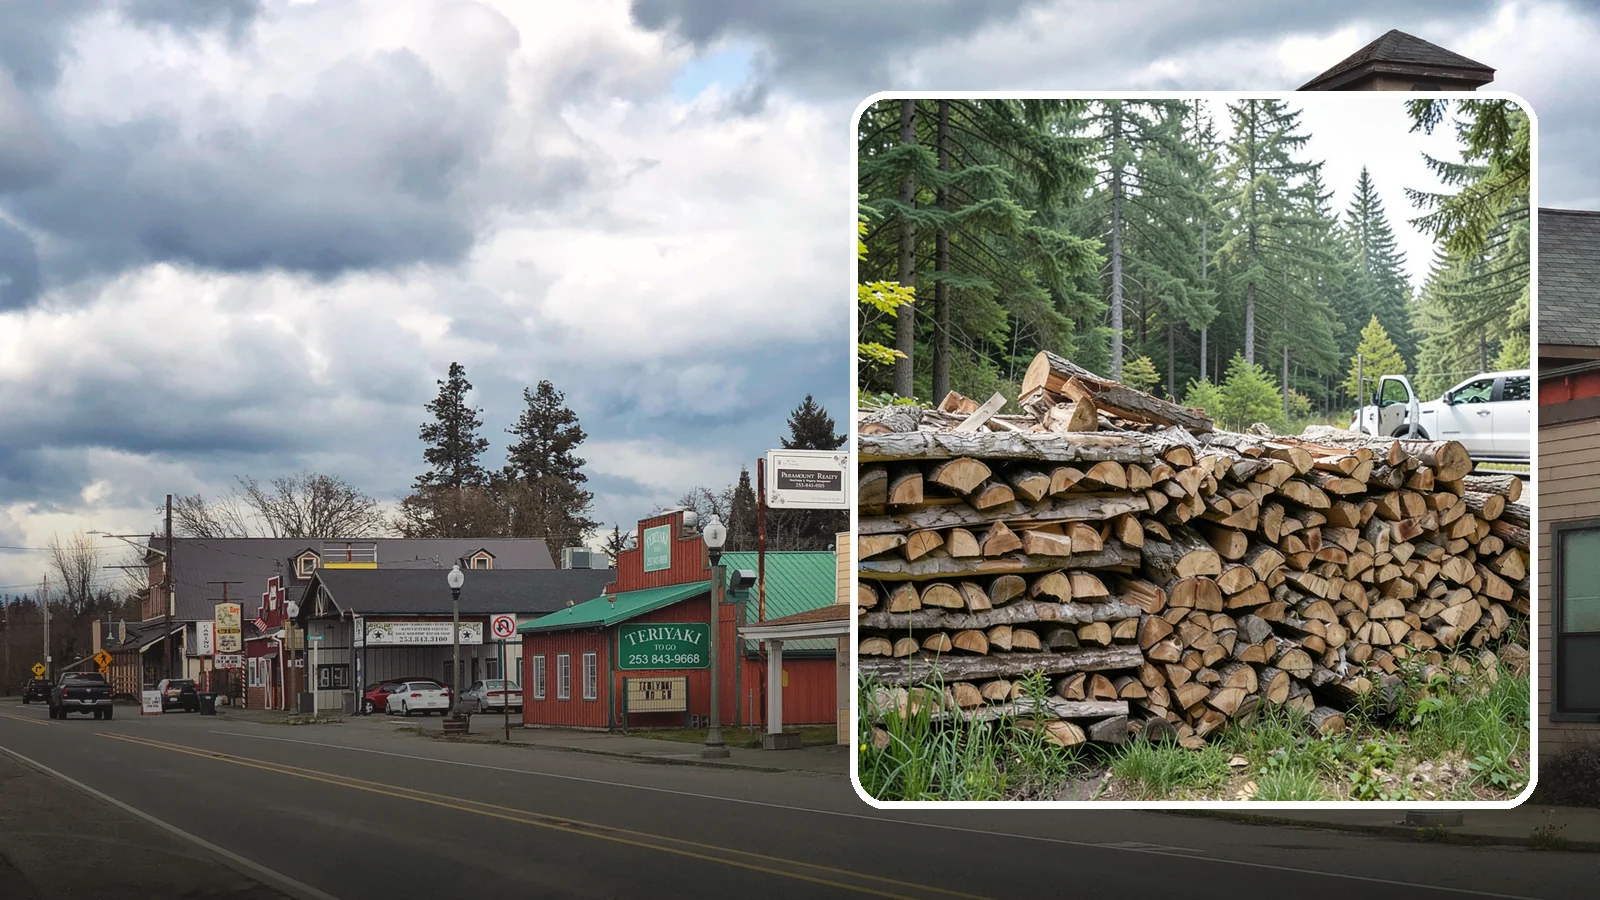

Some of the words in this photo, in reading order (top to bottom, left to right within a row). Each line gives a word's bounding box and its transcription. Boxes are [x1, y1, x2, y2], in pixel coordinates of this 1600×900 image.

[625, 627, 702, 646] TERIYAKI
[629, 654, 648, 664] 253
[651, 654, 700, 664] 843-9668
